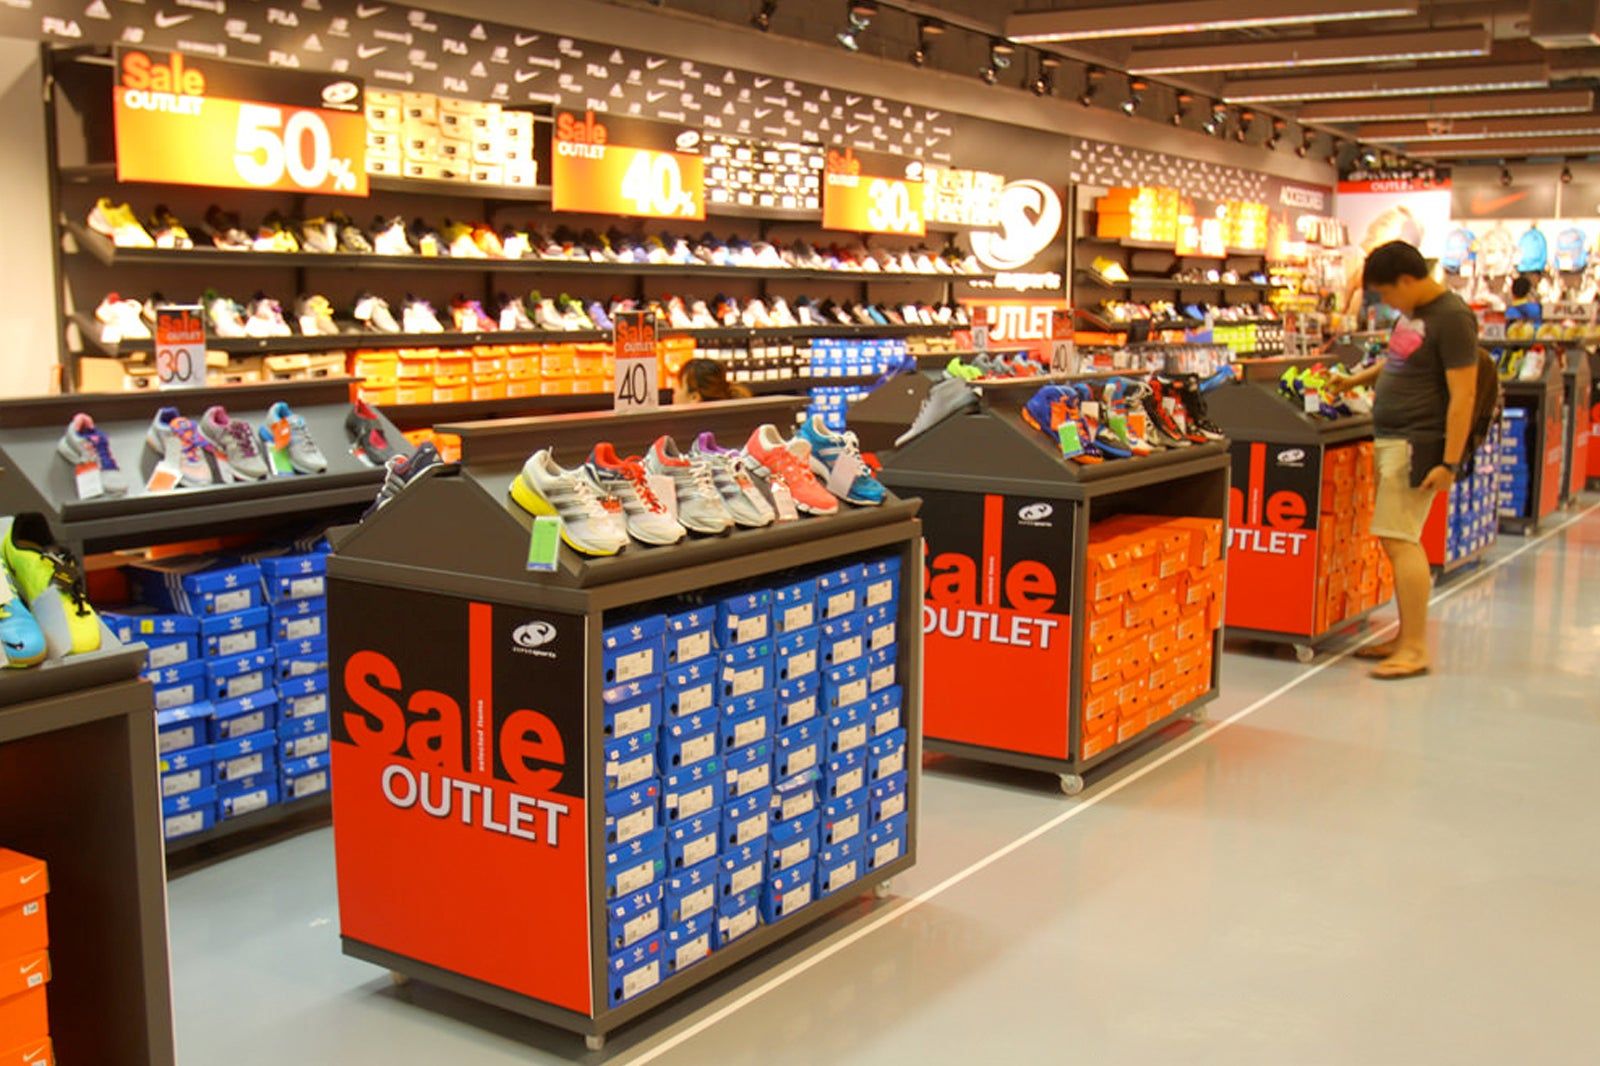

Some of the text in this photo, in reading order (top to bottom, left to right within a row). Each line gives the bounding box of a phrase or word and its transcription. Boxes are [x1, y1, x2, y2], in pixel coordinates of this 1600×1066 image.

[42, 16, 81, 38] FILA
[268, 7, 299, 27] FILA
[269, 50, 300, 68] FILA
[442, 38, 468, 55] FILA
[122, 52, 205, 96] Sale
[443, 77, 469, 93] FILA
[124, 90, 206, 116] OUTLET
[557, 110, 608, 145] Sale
[233, 103, 357, 191] 50%
[557, 141, 607, 160] OUTLET
[159, 310, 203, 334] Sale
[617, 312, 654, 343] Sale
[159, 349, 191, 382] 30
[618, 363, 648, 405] 40
[924, 494, 1057, 614] ale
[343, 602, 565, 793] Sale
[381, 764, 569, 847] OUTLET
